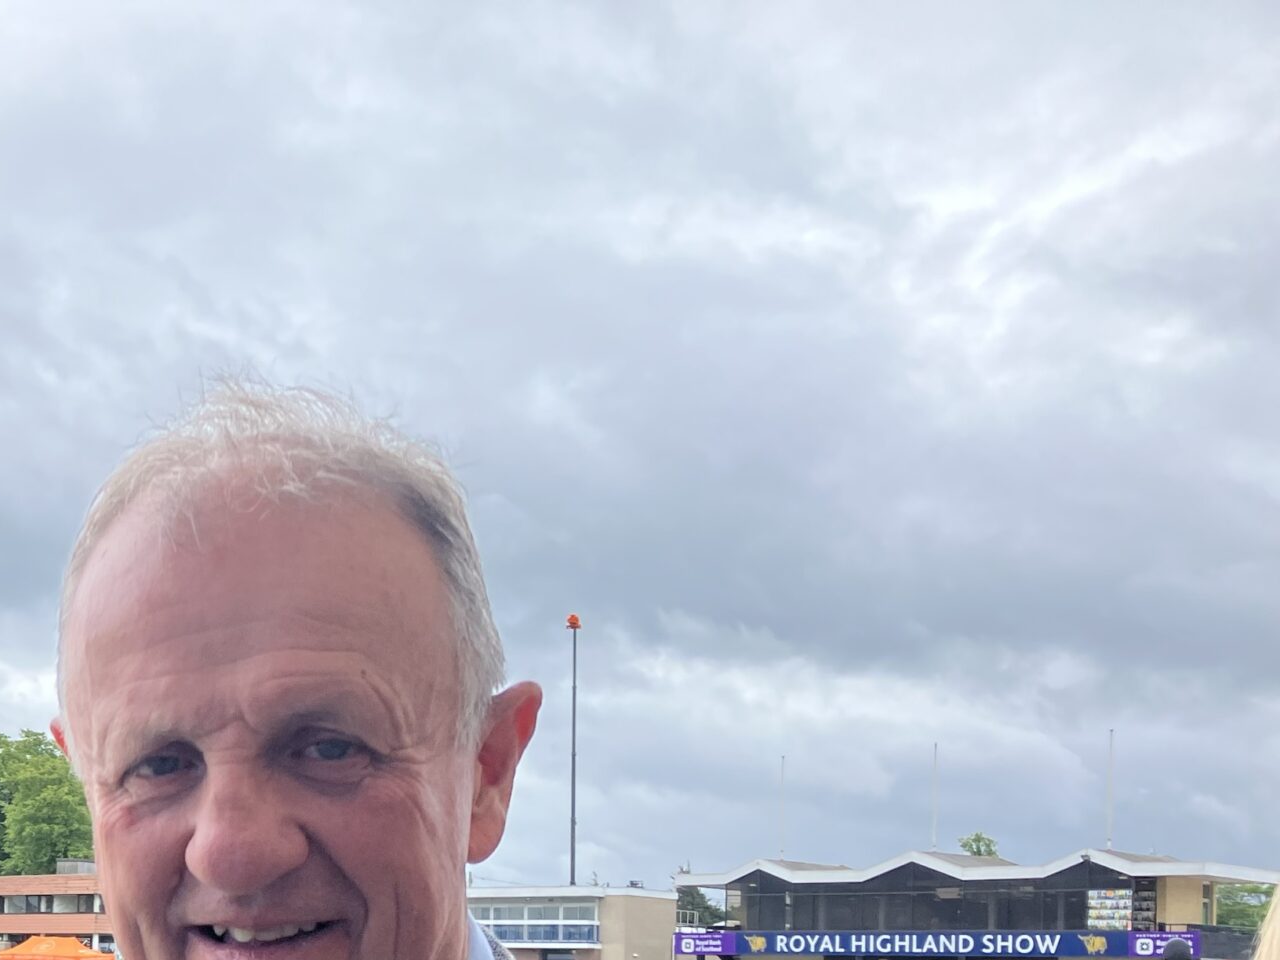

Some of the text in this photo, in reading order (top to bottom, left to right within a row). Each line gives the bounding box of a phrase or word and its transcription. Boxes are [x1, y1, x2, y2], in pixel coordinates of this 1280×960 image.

[776, 934, 1061, 954] ROYAL HIGHLAND SHOW
